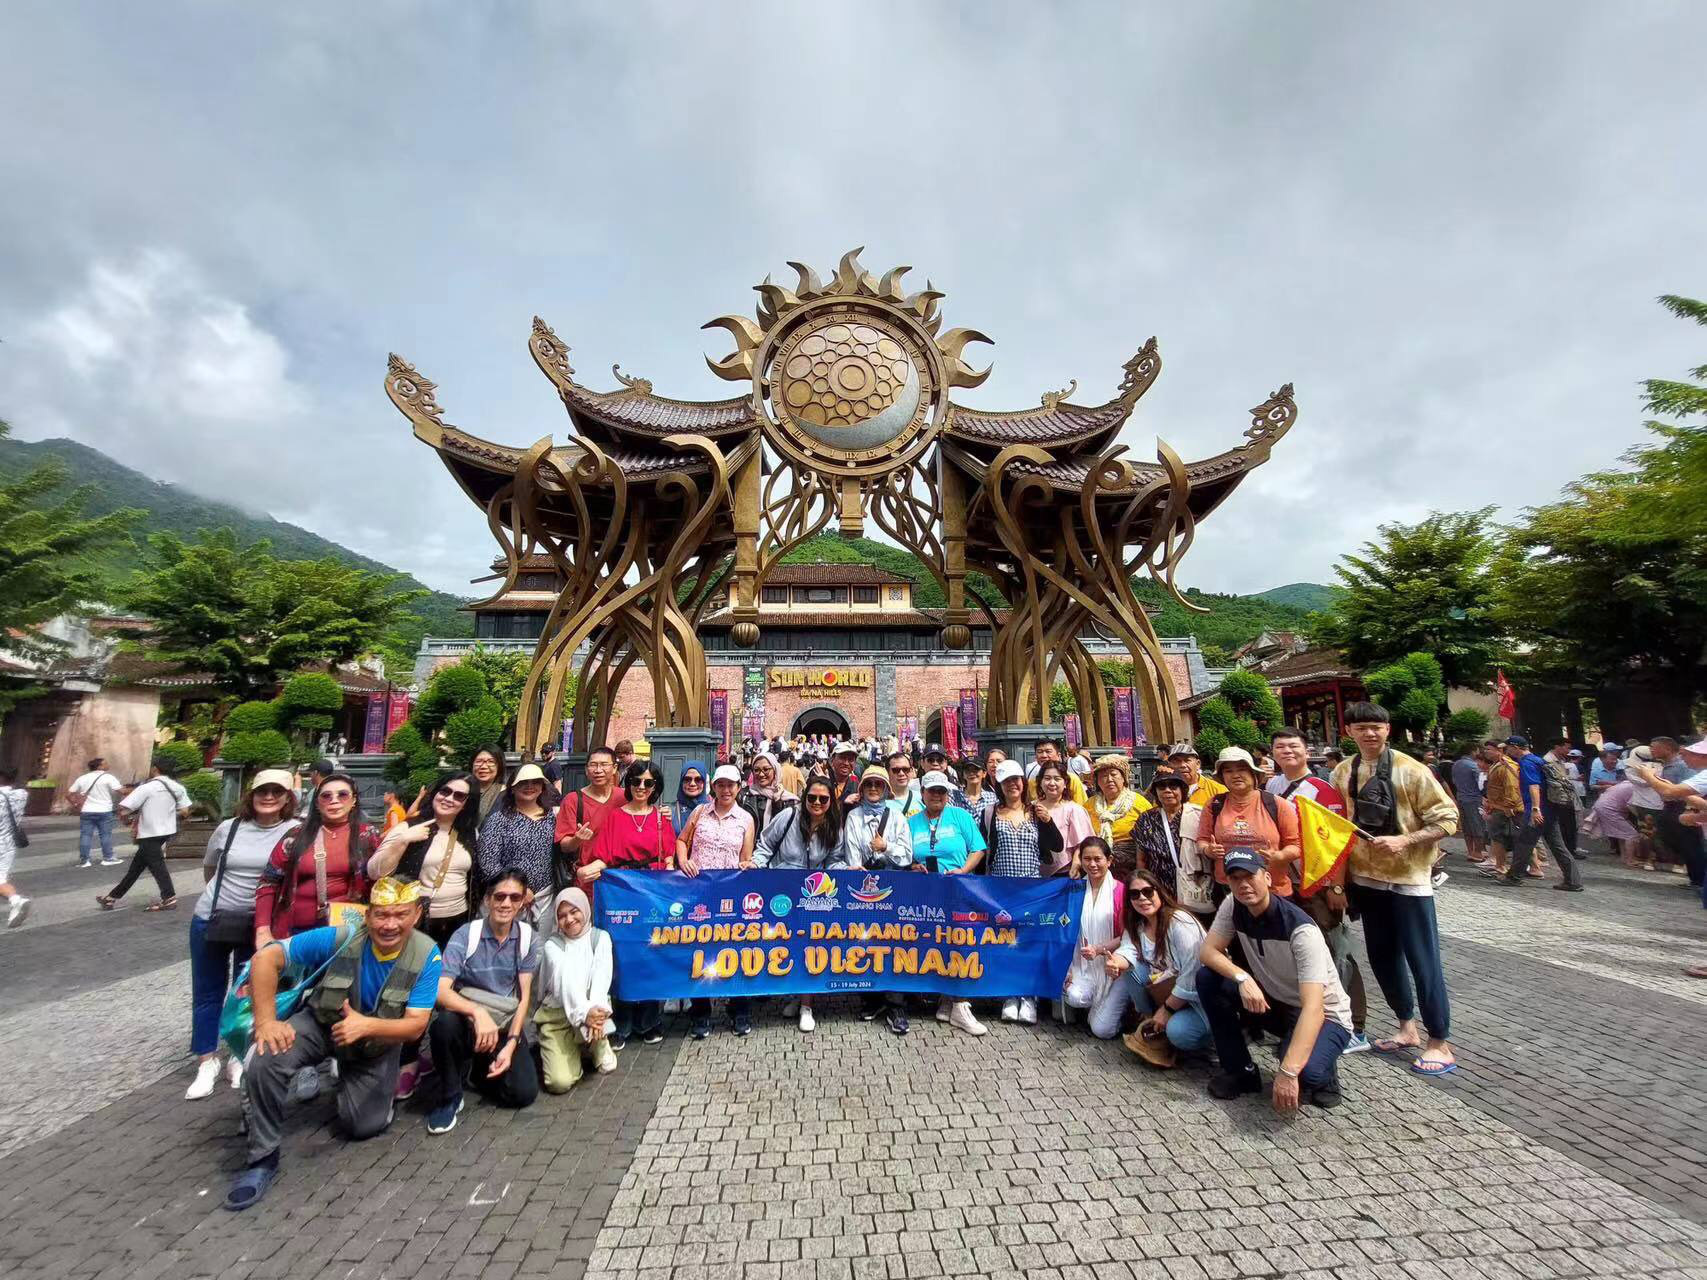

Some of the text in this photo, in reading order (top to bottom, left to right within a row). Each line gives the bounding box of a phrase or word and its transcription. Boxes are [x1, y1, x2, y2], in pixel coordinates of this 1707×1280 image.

[770, 668, 804, 687] SUN
[808, 668, 871, 688] WORLD
[652, 922, 792, 944] INDONESIA
[691, 946, 984, 979] LOVE VIETNAM
